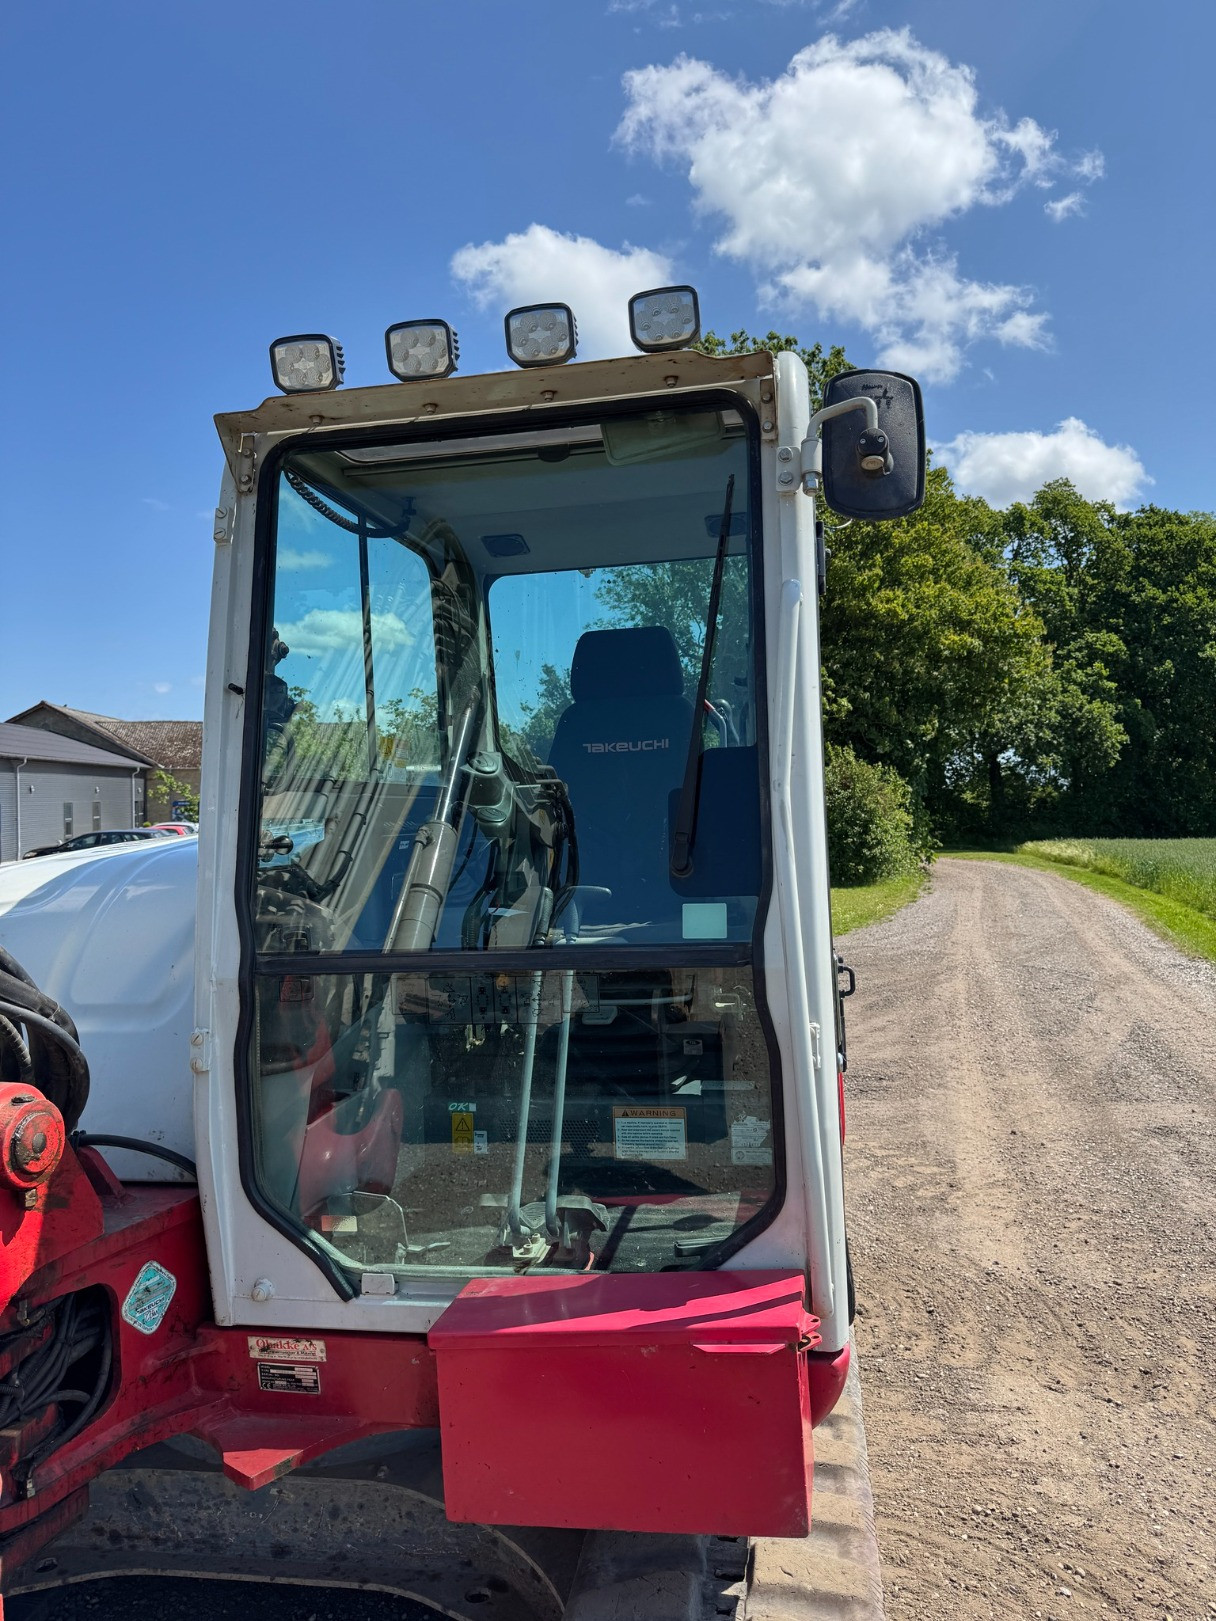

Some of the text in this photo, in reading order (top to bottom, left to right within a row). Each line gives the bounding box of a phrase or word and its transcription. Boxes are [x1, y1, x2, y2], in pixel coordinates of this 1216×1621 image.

[582, 738, 669, 753] TAKEUCHI
[448, 1102, 469, 1111] OK
[630, 1109, 677, 1117] WARNING
